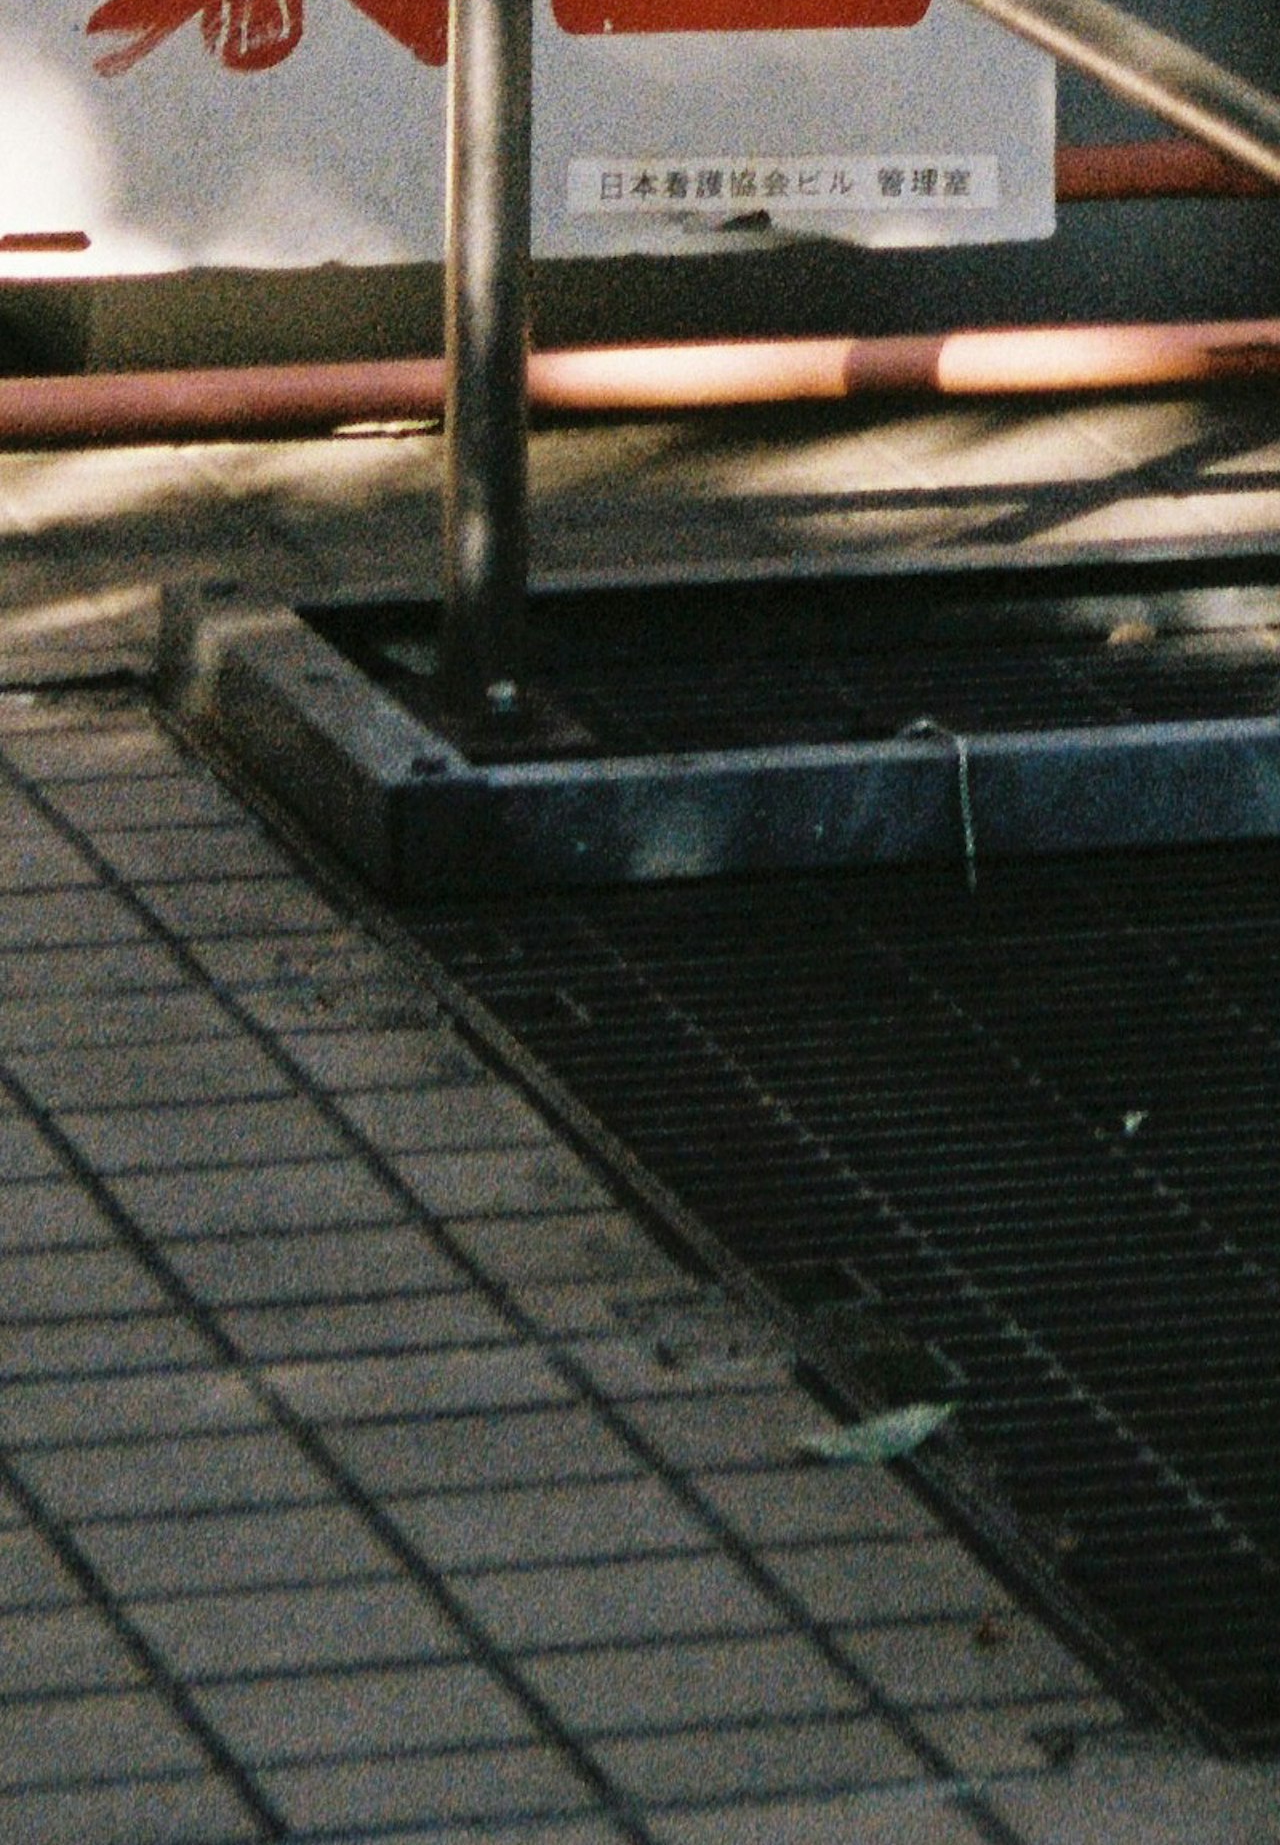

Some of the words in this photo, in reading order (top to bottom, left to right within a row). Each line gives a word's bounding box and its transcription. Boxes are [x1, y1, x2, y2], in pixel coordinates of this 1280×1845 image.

[600, 168, 853, 200] 日本看護協会ビル
[877, 167, 972, 197] 管理室
